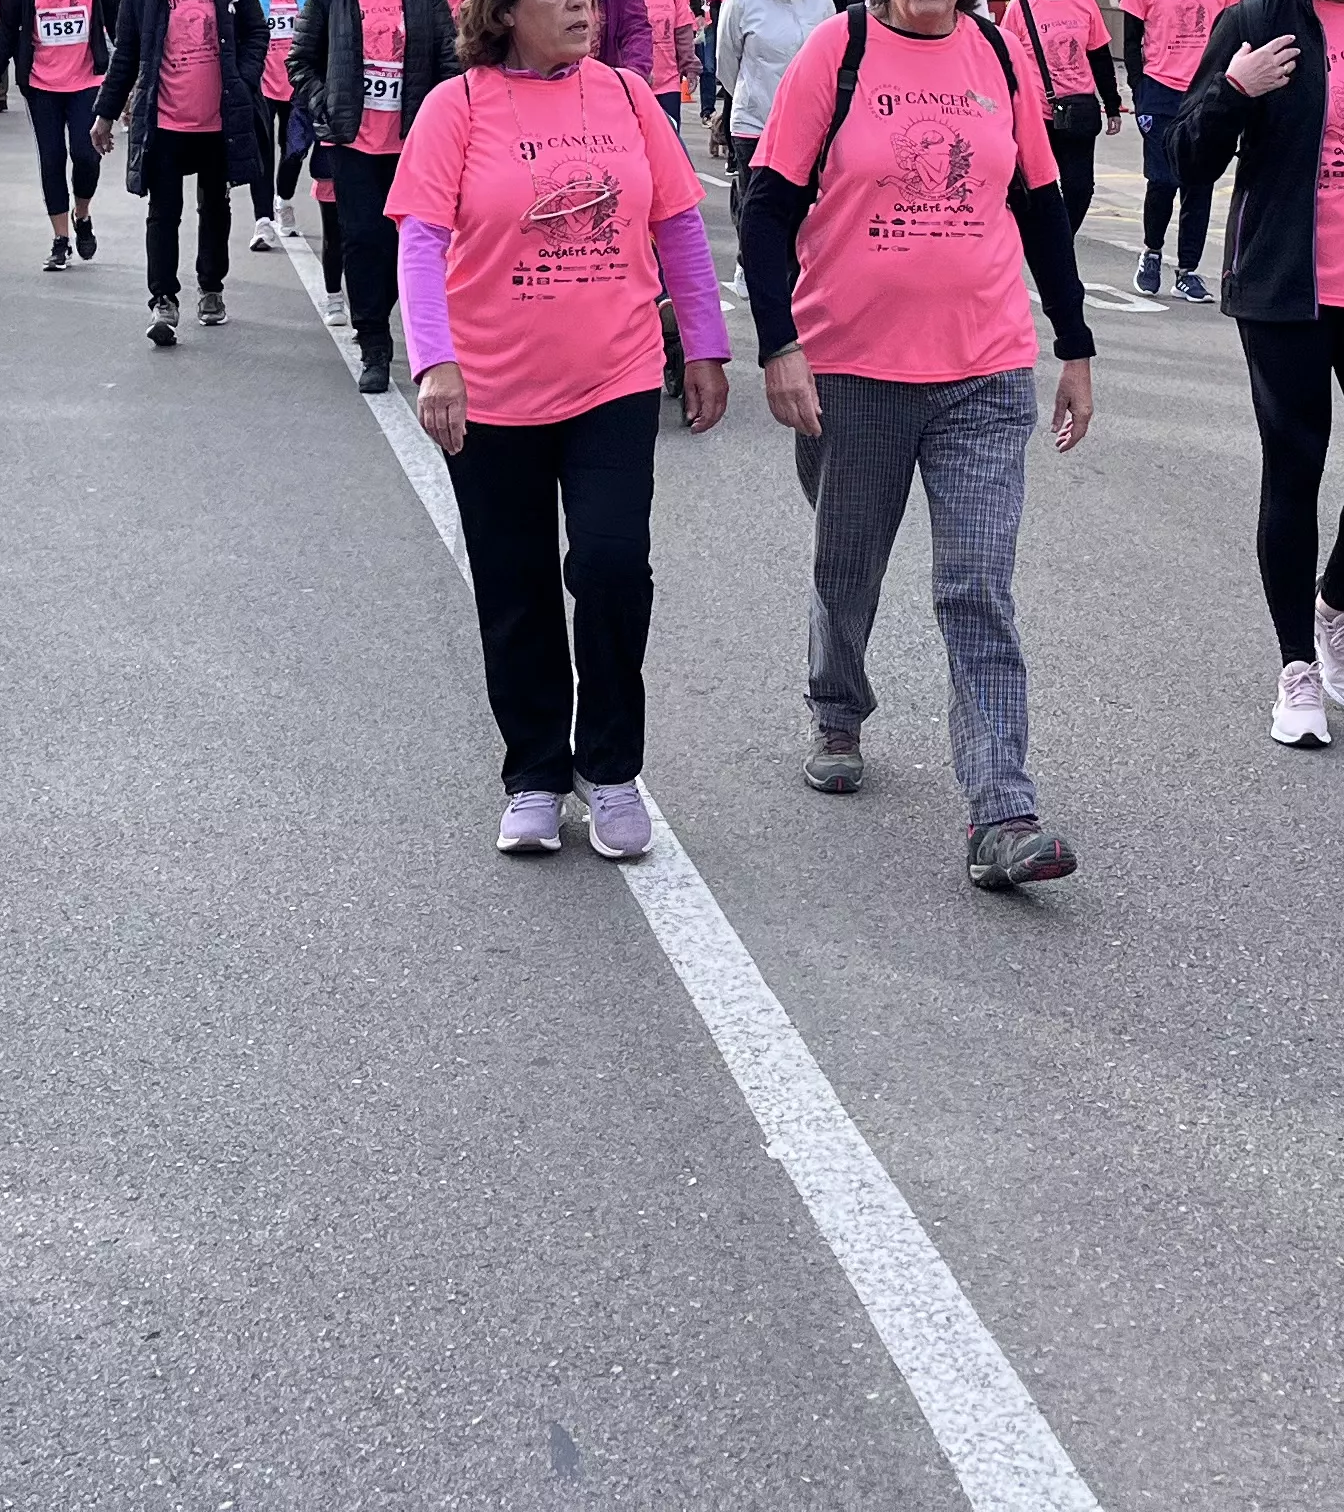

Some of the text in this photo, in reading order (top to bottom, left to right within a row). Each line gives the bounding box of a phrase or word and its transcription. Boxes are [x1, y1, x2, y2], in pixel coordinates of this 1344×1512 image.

[43, 19, 84, 36] 1587
[905, 89, 970, 108] CÁNCER
[941, 105, 983, 118] HUESCA
[547, 133, 614, 148] CÁNCER
